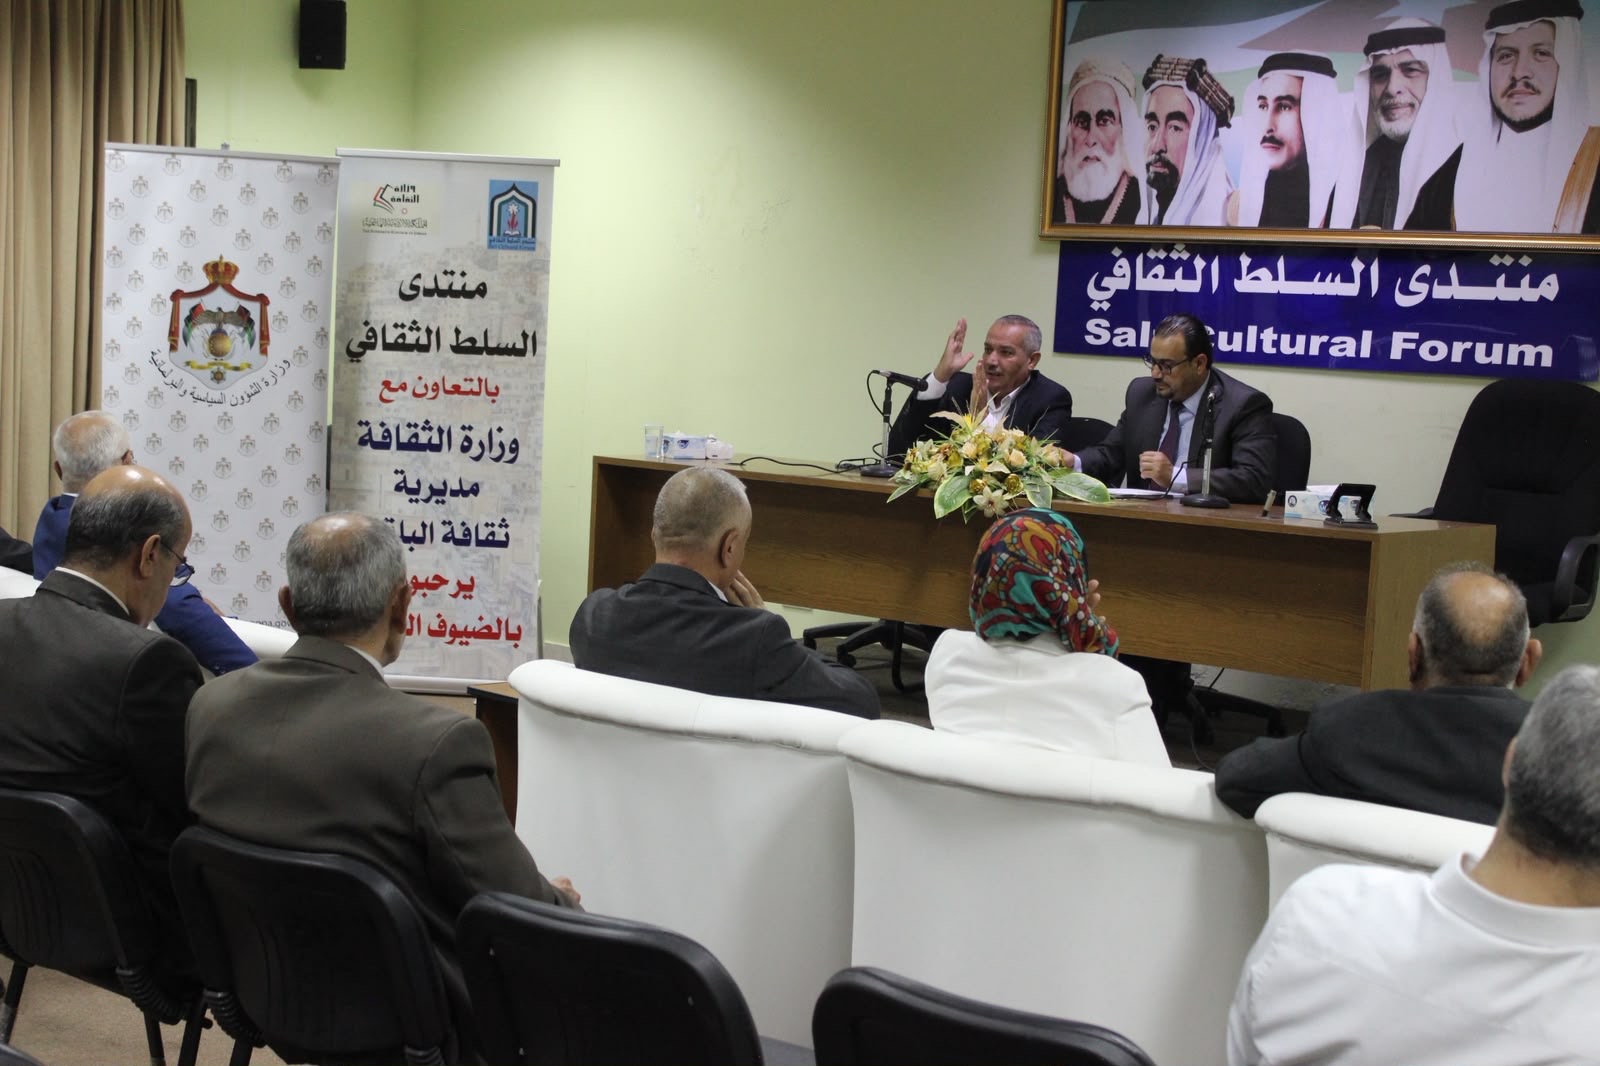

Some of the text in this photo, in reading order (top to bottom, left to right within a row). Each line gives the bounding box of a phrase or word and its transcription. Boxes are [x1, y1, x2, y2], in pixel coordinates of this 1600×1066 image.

[398, 269, 488, 302] منتدى
[1086, 243, 1560, 312] منتدى السلط الثقافي
[345, 319, 538, 363] السلط الثقافي
[1084, 317, 1156, 349] Sal
[1390, 331, 1554, 368] Forum
[260, 359, 292, 388] وزارة
[378, 375, 500, 404] بالتعاون مع
[356, 419, 520, 464] وزارة الثقافة
[393, 468, 481, 505] مديرية
[440, 517, 511, 549] ثقافة
[410, 573, 476, 600] يرحبو
[427, 613, 523, 649] بالضيوف
